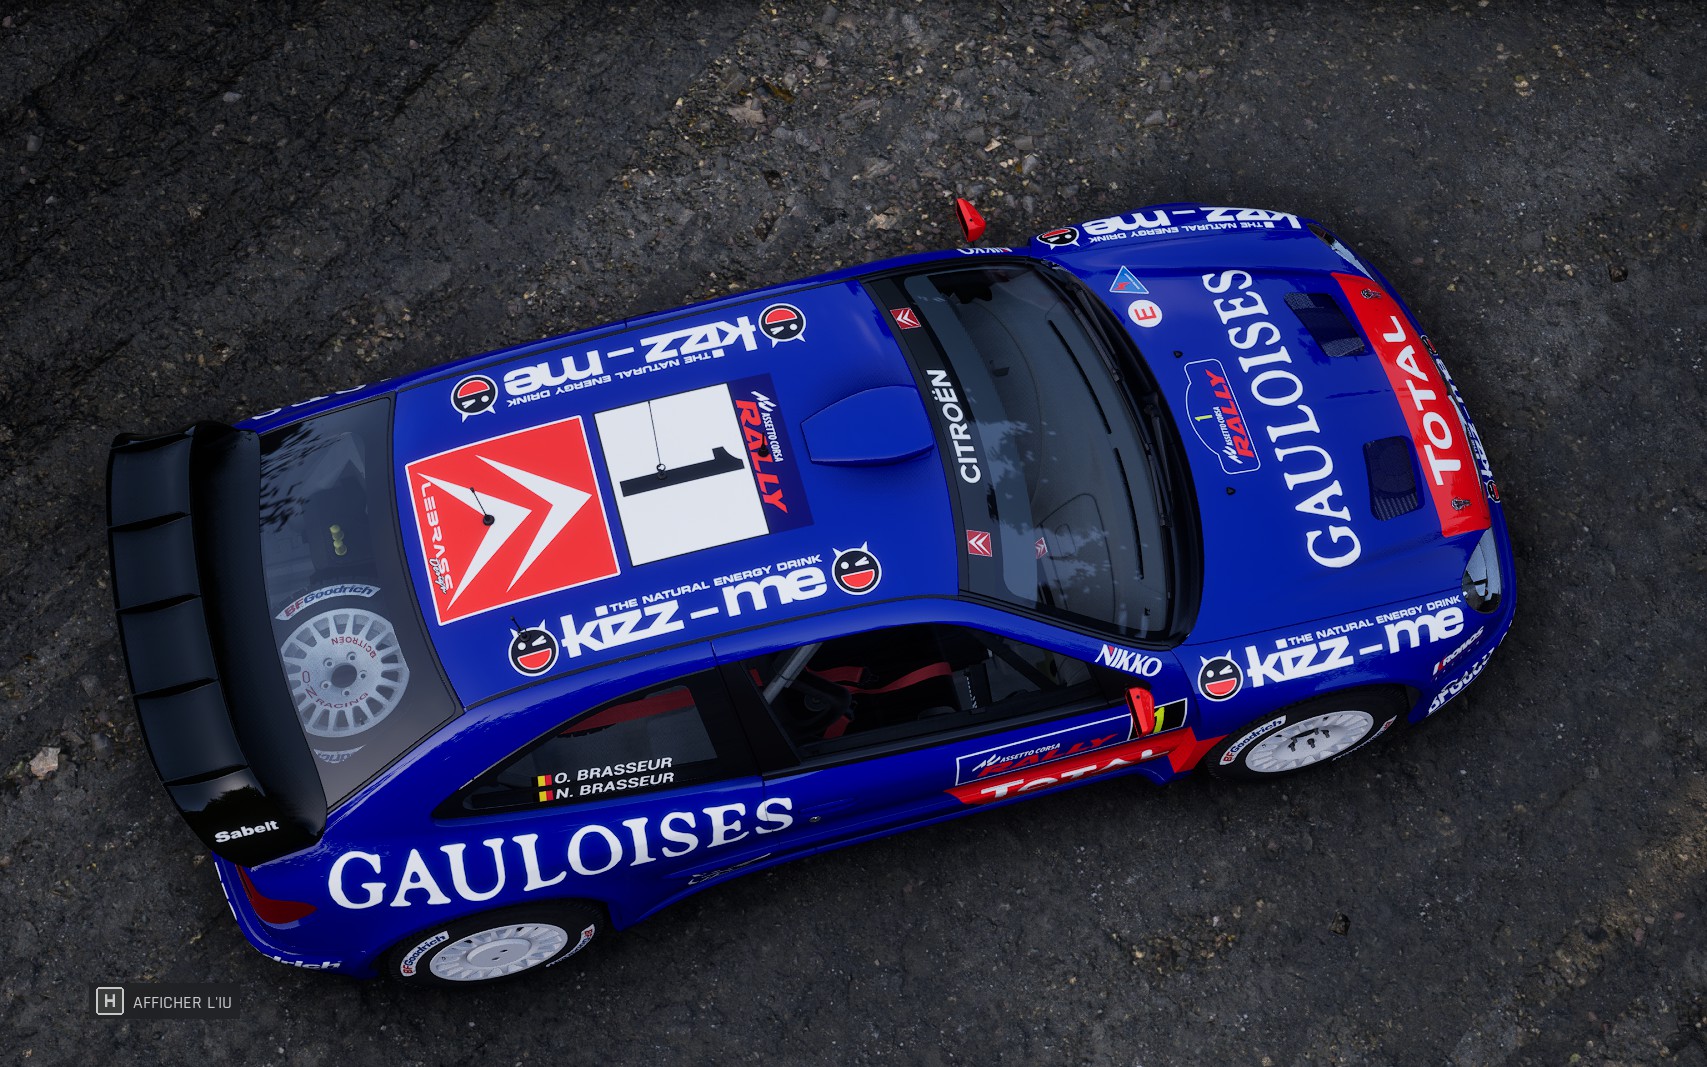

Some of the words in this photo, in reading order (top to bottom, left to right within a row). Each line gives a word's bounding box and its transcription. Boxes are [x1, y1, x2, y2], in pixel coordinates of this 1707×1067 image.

[1089, 232, 1127, 244] DRINK
[1130, 227, 1179, 239] ENERGY
[1181, 221, 1237, 232] NATURAL
[1239, 221, 1263, 229] THE
[614, 358, 681, 380] NATURAL
[684, 352, 711, 365] THE
[507, 388, 551, 408] DRINK
[555, 373, 612, 395] ENERGY
[1205, 368, 1255, 458] RALLY
[1382, 315, 1462, 486] TOTAL
[761, 411, 778, 441] ASSETTO
[926, 369, 982, 484] CITROËN
[1194, 414, 1213, 422] 1
[1202, 269, 1362, 568] GAULOISES
[735, 399, 788, 513] RALLY
[769, 440, 784, 463] CORSA
[619, 446, 745, 497] 1
[608, 597, 638, 614] THE
[642, 581, 711, 604] NATURAL
[713, 565, 772, 587] ENERGY
[776, 554, 822, 572] DRINK
[284, 584, 374, 618] BFGoodrich
[1287, 633, 1313, 647] THE
[1316, 618, 1374, 641] NATURAL
[1376, 604, 1423, 625] ENERGY
[1426, 595, 1461, 611] DRINK
[1094, 644, 1163, 677] NIKKO
[977, 733, 1118, 778] RALLY
[1000, 749, 1034, 764] ASSETTO
[1035, 742, 1061, 754] CORSA
[1222, 718, 1283, 763] BFGoodrich
[554, 771, 571, 785] O.
[577, 756, 673, 782] BRASSEUR
[555, 788, 574, 800] N.
[579, 772, 675, 797] BRASSEUR
[214, 820, 279, 843] Sabelt
[327, 797, 794, 910] GAULOISES
[402, 934, 446, 975] BFGoodrich
